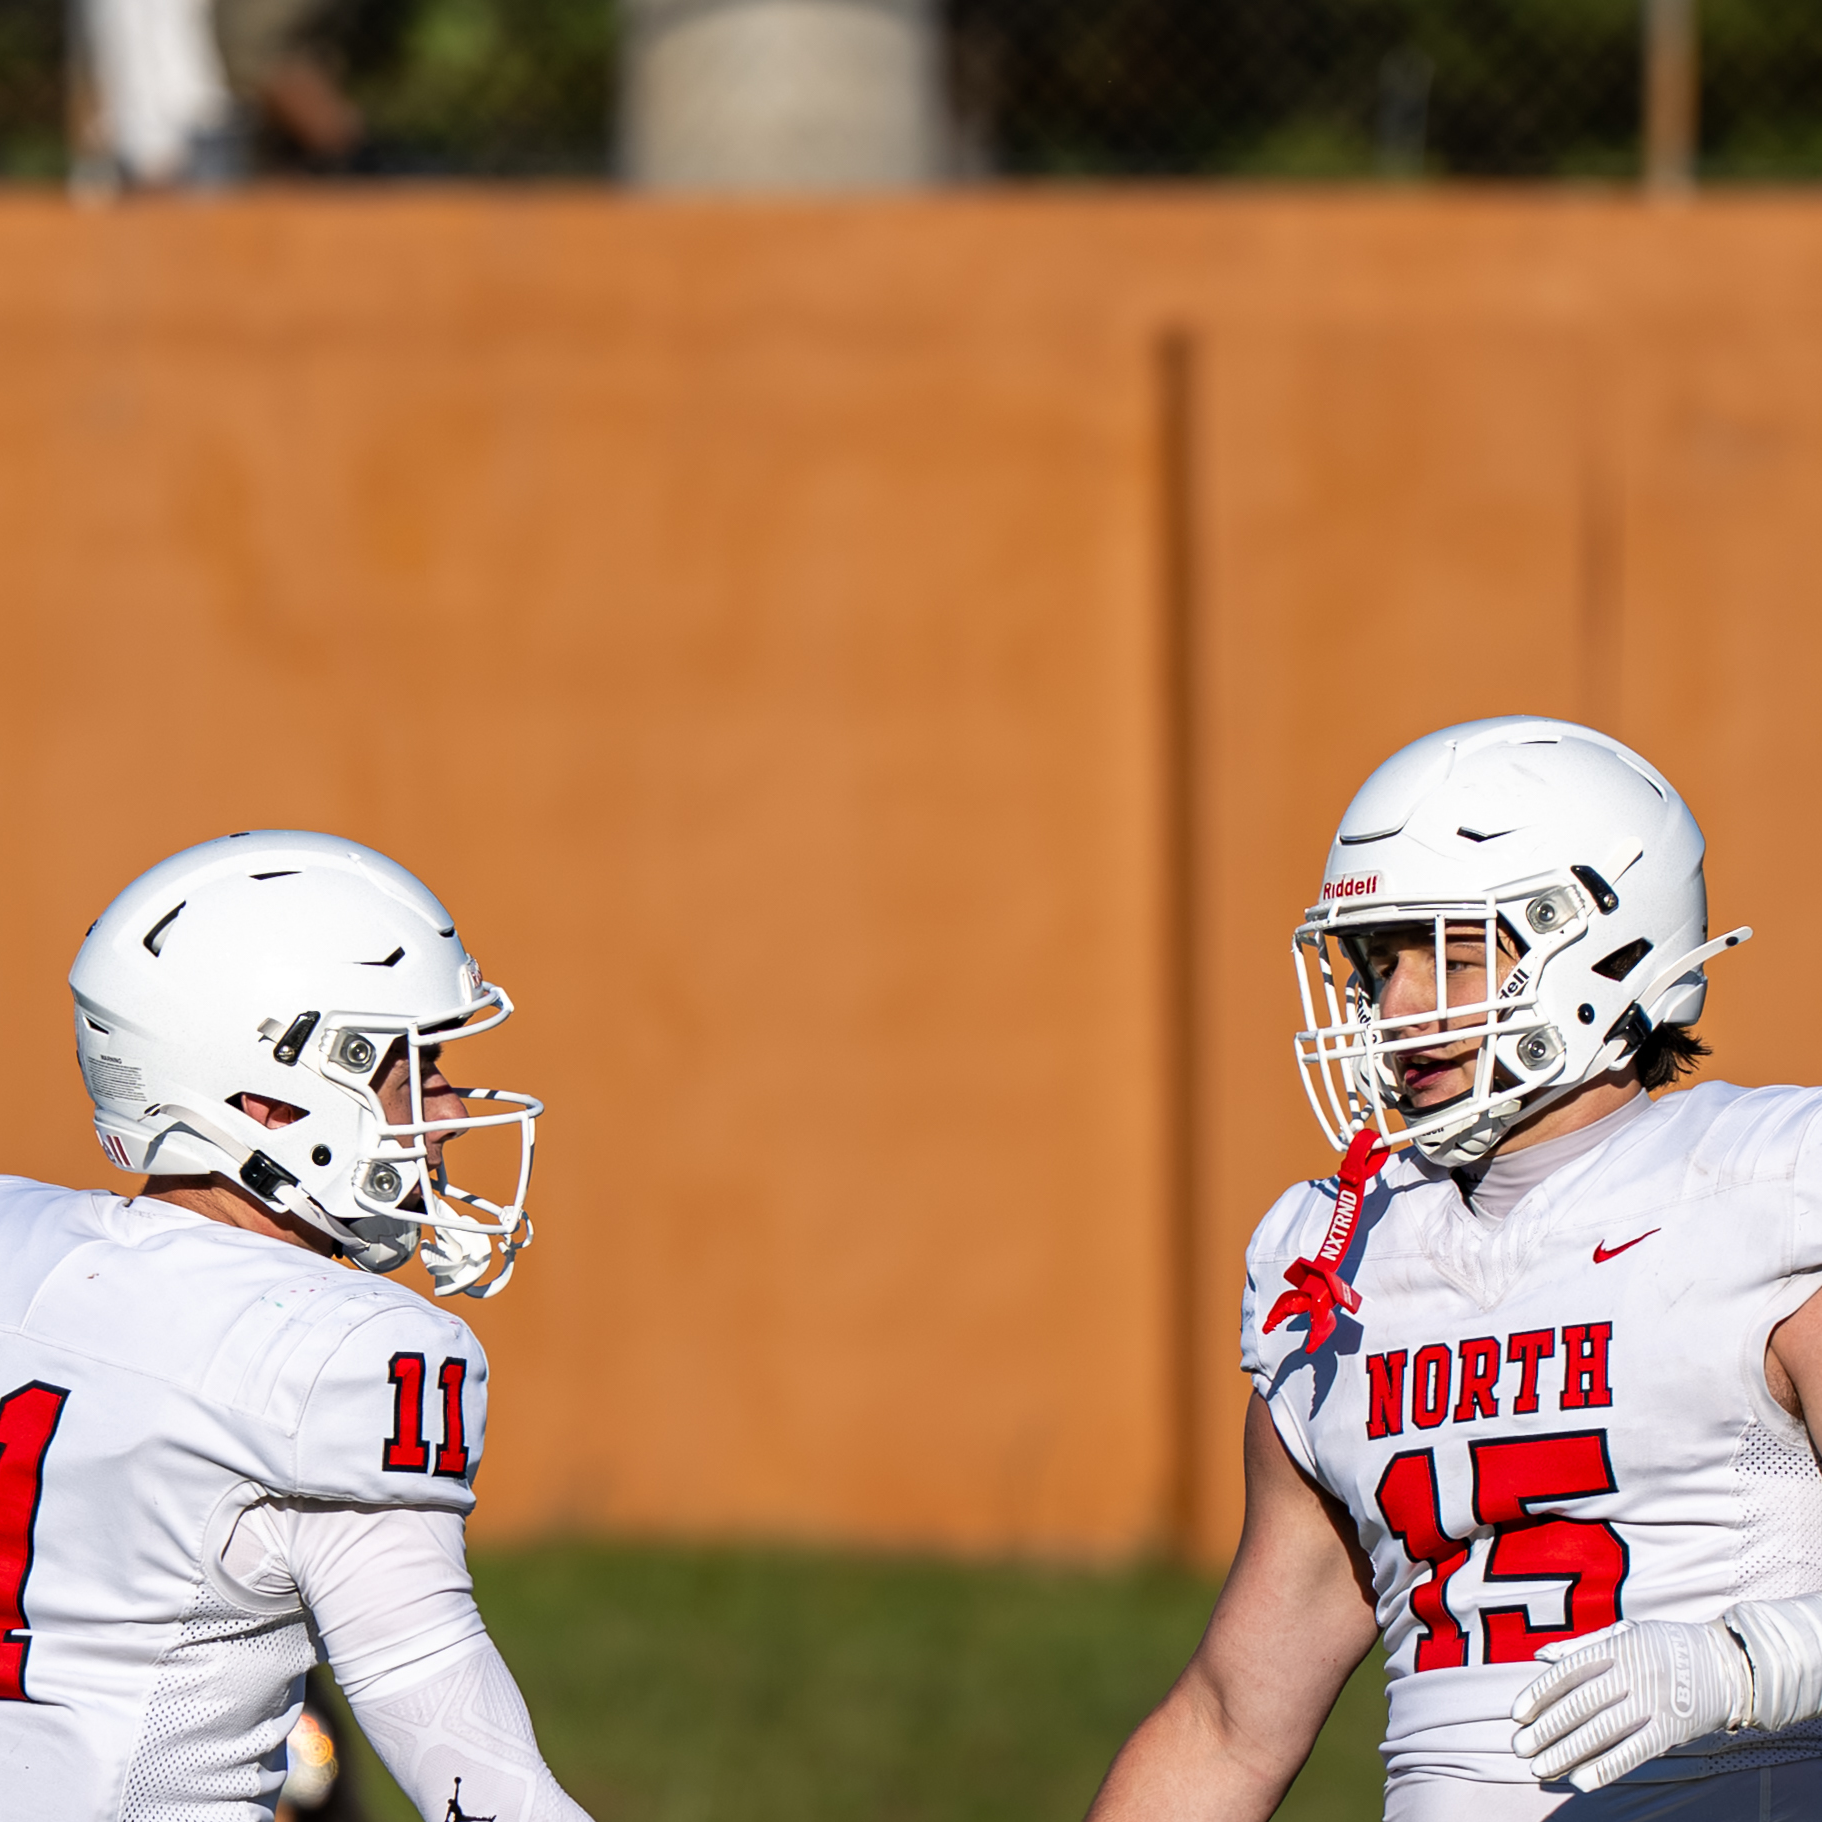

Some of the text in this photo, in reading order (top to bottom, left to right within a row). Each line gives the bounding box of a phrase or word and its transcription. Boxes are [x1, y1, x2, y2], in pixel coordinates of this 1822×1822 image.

[1322, 874, 1378, 901] Riddell
[1320, 1189, 1358, 1262] NXTRND
[382, 1351, 469, 1480] 11
[1366, 1320, 1614, 1440] NORTH
[1374, 1428, 1630, 1673] 15
